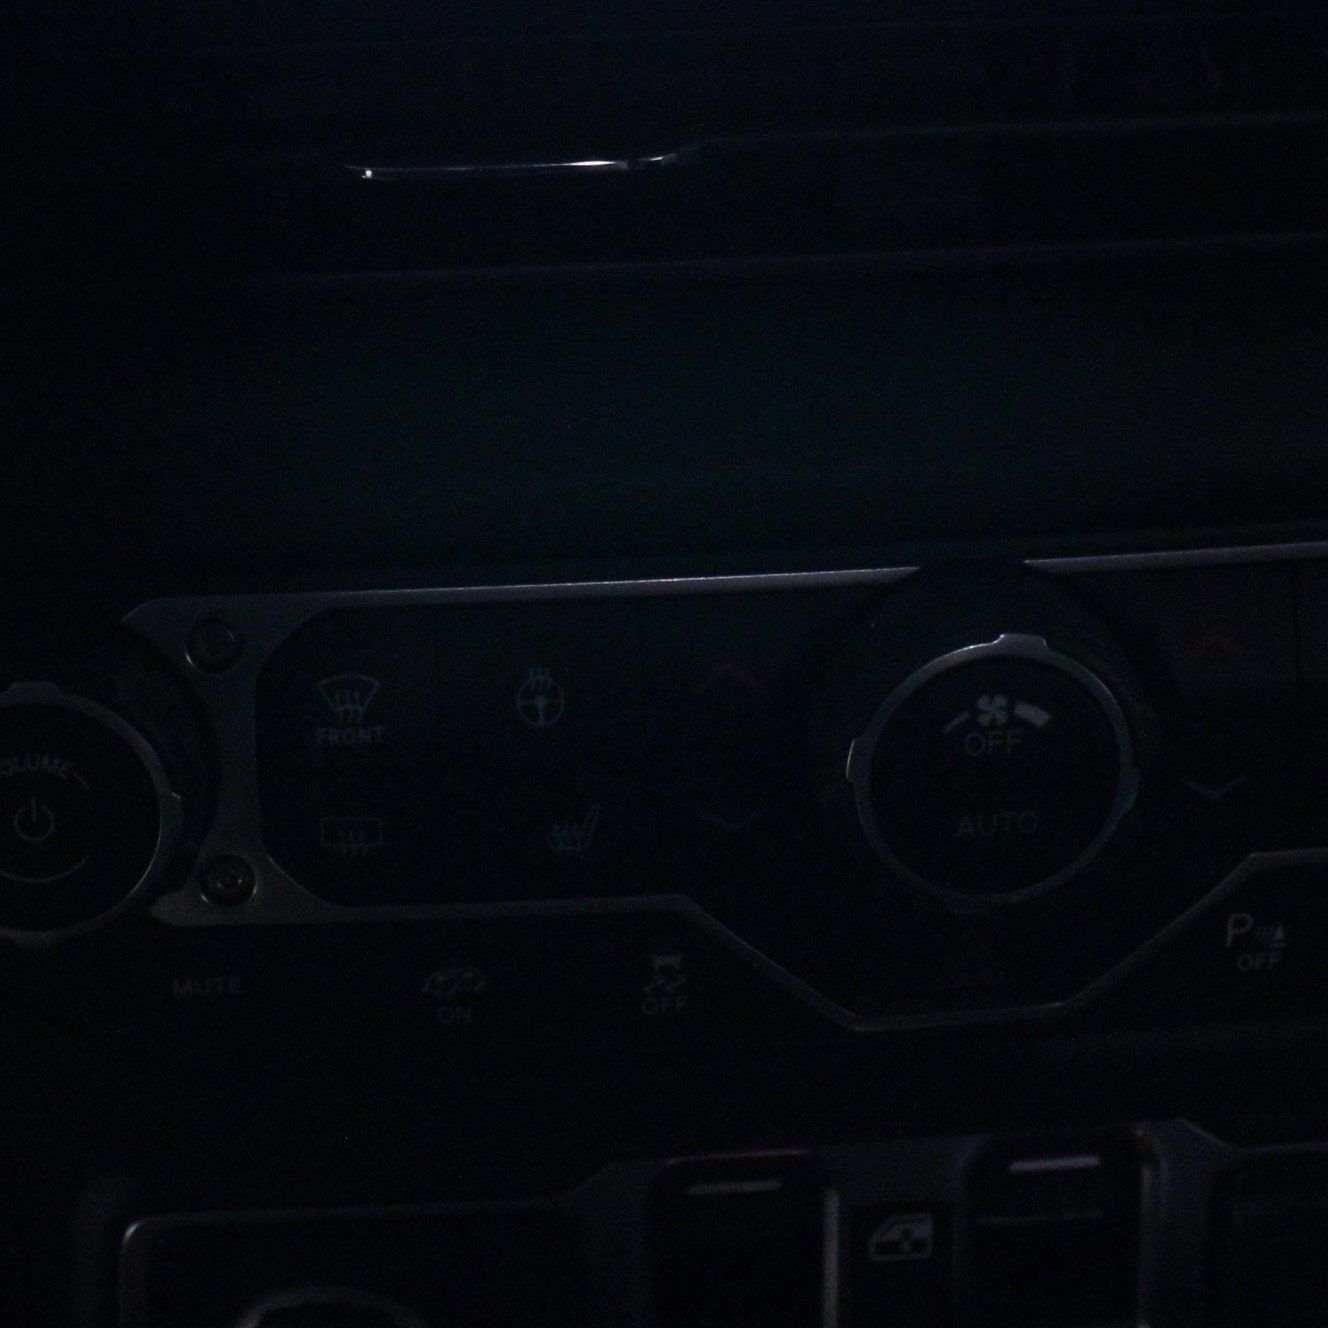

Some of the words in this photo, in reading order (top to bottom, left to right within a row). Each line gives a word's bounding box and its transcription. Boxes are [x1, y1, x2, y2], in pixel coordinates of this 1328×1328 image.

[316, 727, 384, 744] FRONT
[963, 727, 1024, 756] OFF
[956, 810, 1039, 838] AUTO
[1237, 950, 1281, 972] OFF
[174, 978, 242, 996] MUTE
[640, 996, 688, 1016] OFF
